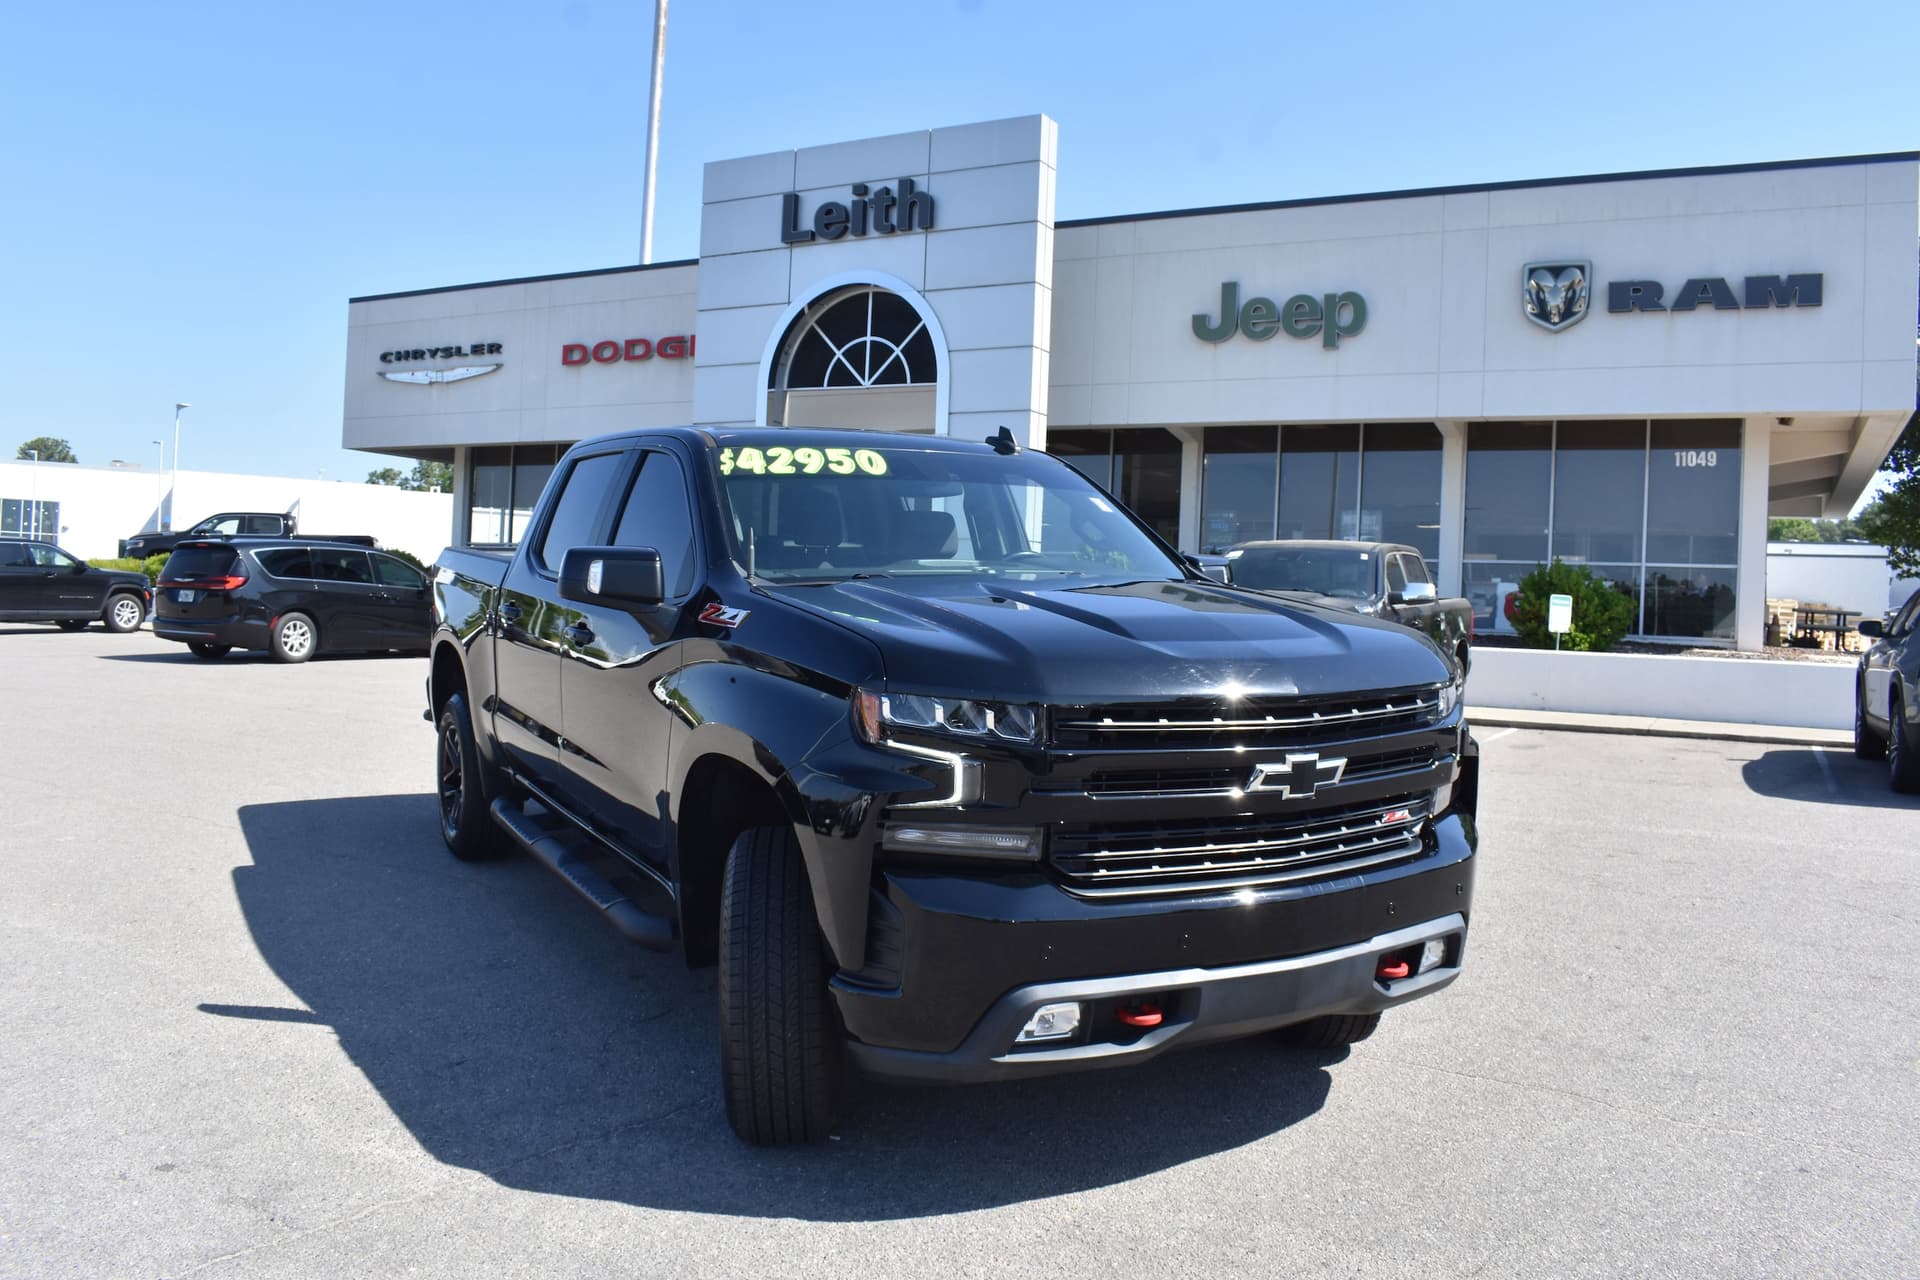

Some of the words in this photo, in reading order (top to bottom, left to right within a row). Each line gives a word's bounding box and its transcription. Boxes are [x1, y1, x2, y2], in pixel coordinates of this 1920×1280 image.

[781, 176, 935, 244] Leith
[1608, 273, 1824, 313] RAM
[1192, 281, 1367, 350] Jeep
[380, 342, 503, 363] CHRYSLER
[561, 334, 696, 366] DODG
[719, 446, 888, 476] $42950
[1674, 450, 1717, 468] 11049
[698, 602, 751, 628] Z71
